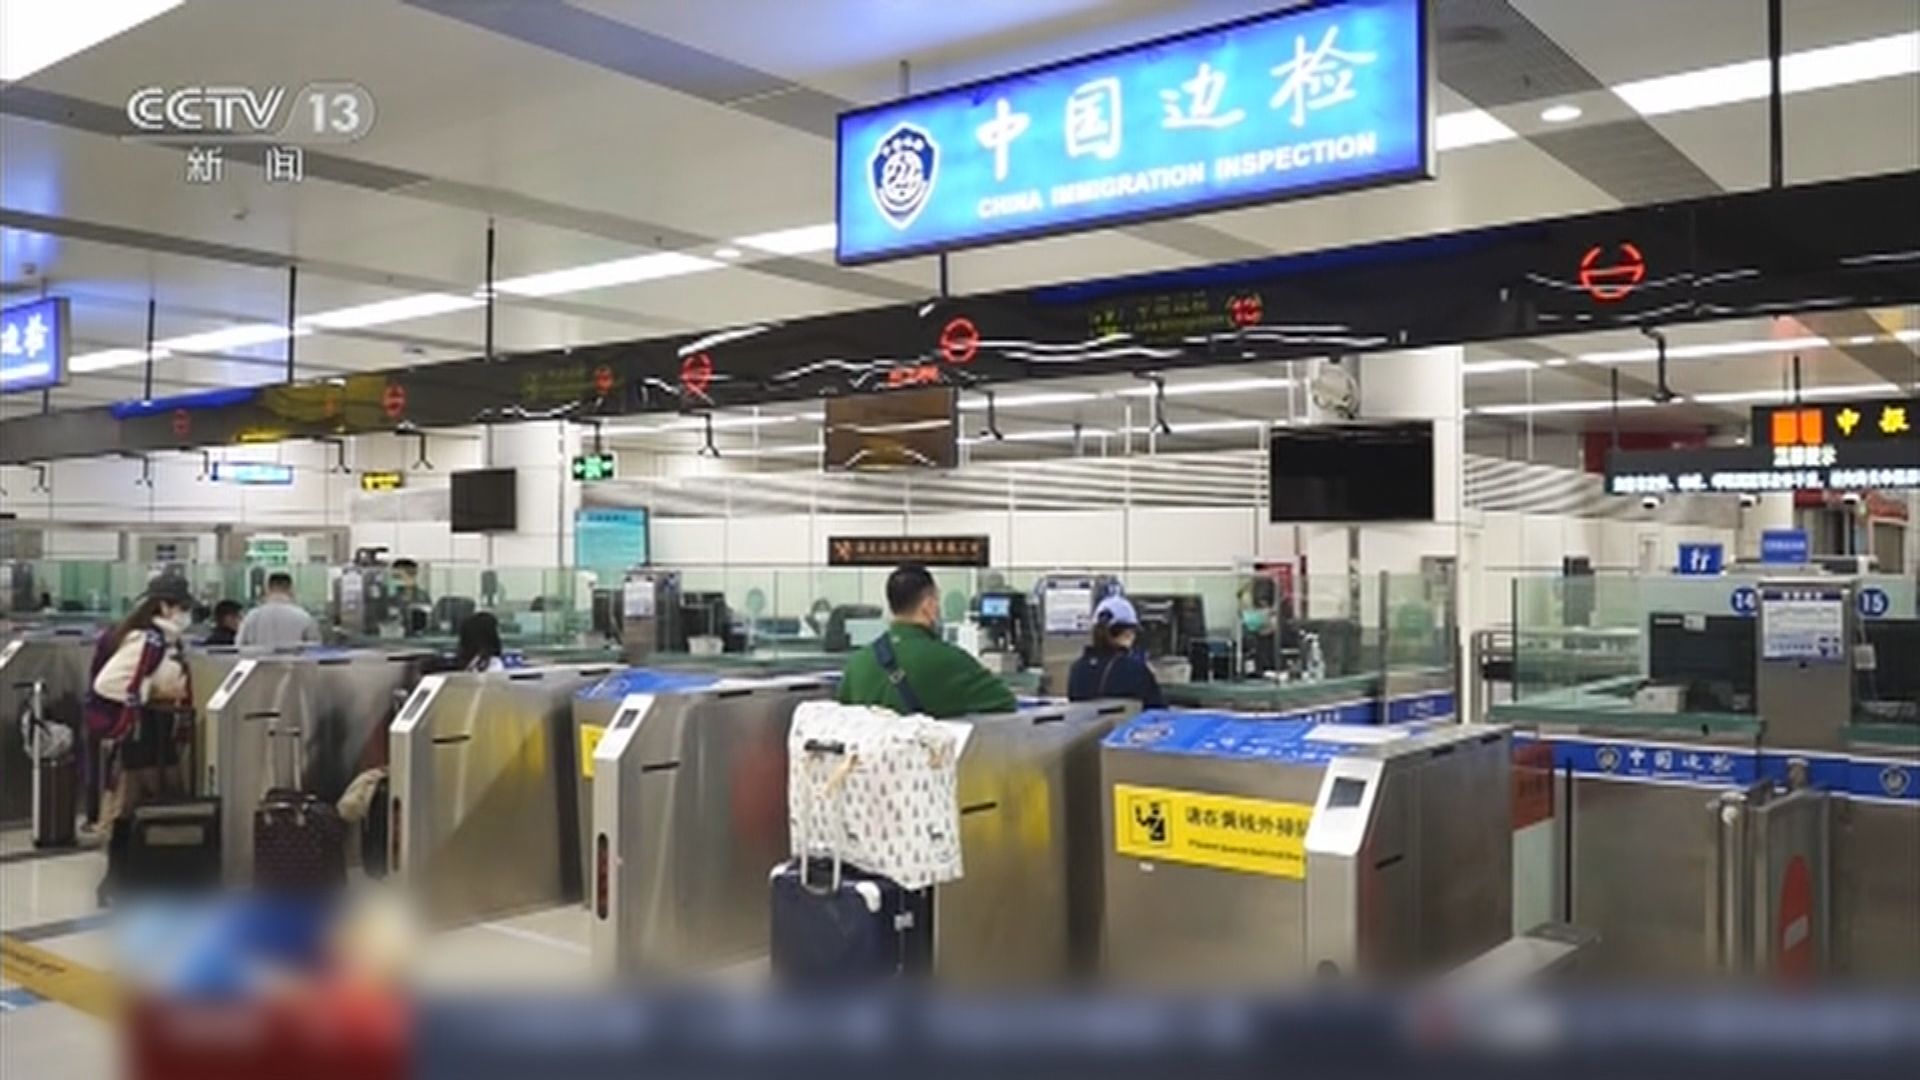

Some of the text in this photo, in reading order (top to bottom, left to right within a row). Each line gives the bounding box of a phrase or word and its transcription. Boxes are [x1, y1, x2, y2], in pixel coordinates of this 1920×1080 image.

[977, 26, 1378, 182] 中国边检
[978, 133, 1378, 218] CHINA IMMIGRATION INSPECTION
[1862, 592, 1883, 612] 15
